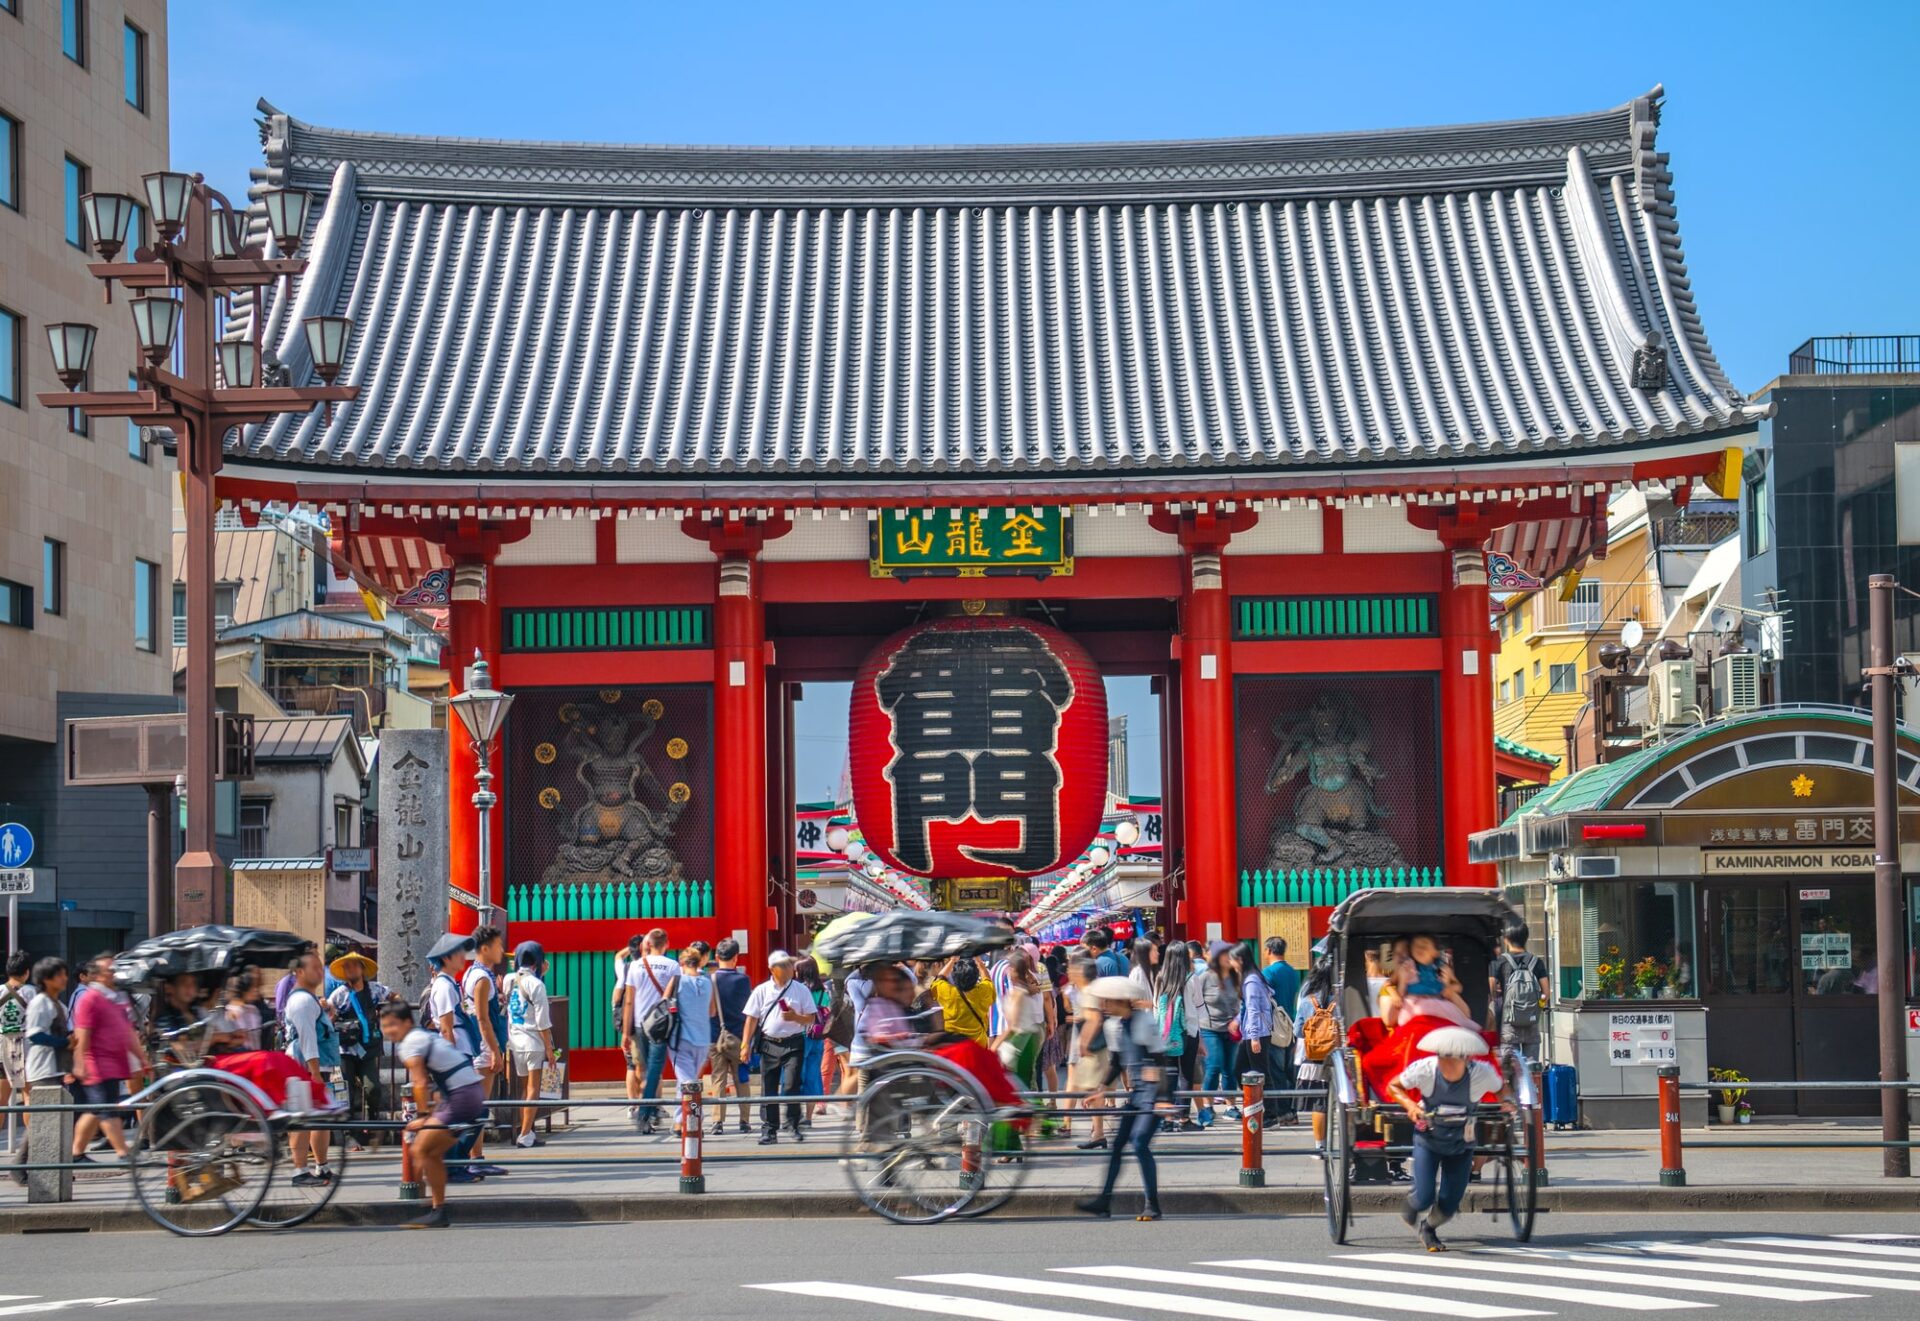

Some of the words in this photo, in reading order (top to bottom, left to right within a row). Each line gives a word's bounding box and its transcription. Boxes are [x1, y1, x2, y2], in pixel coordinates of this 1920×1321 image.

[874, 627, 1076, 874] 雷門
[797, 821, 822, 849] 仲
[1794, 816, 1874, 841] 雷門交
[1716, 855, 1823, 869] KAMINARIMON
[1612, 1031, 1632, 1041] 死亡
[1661, 1031, 1669, 1041] 0
[1613, 1049, 1631, 1059] 負傷
